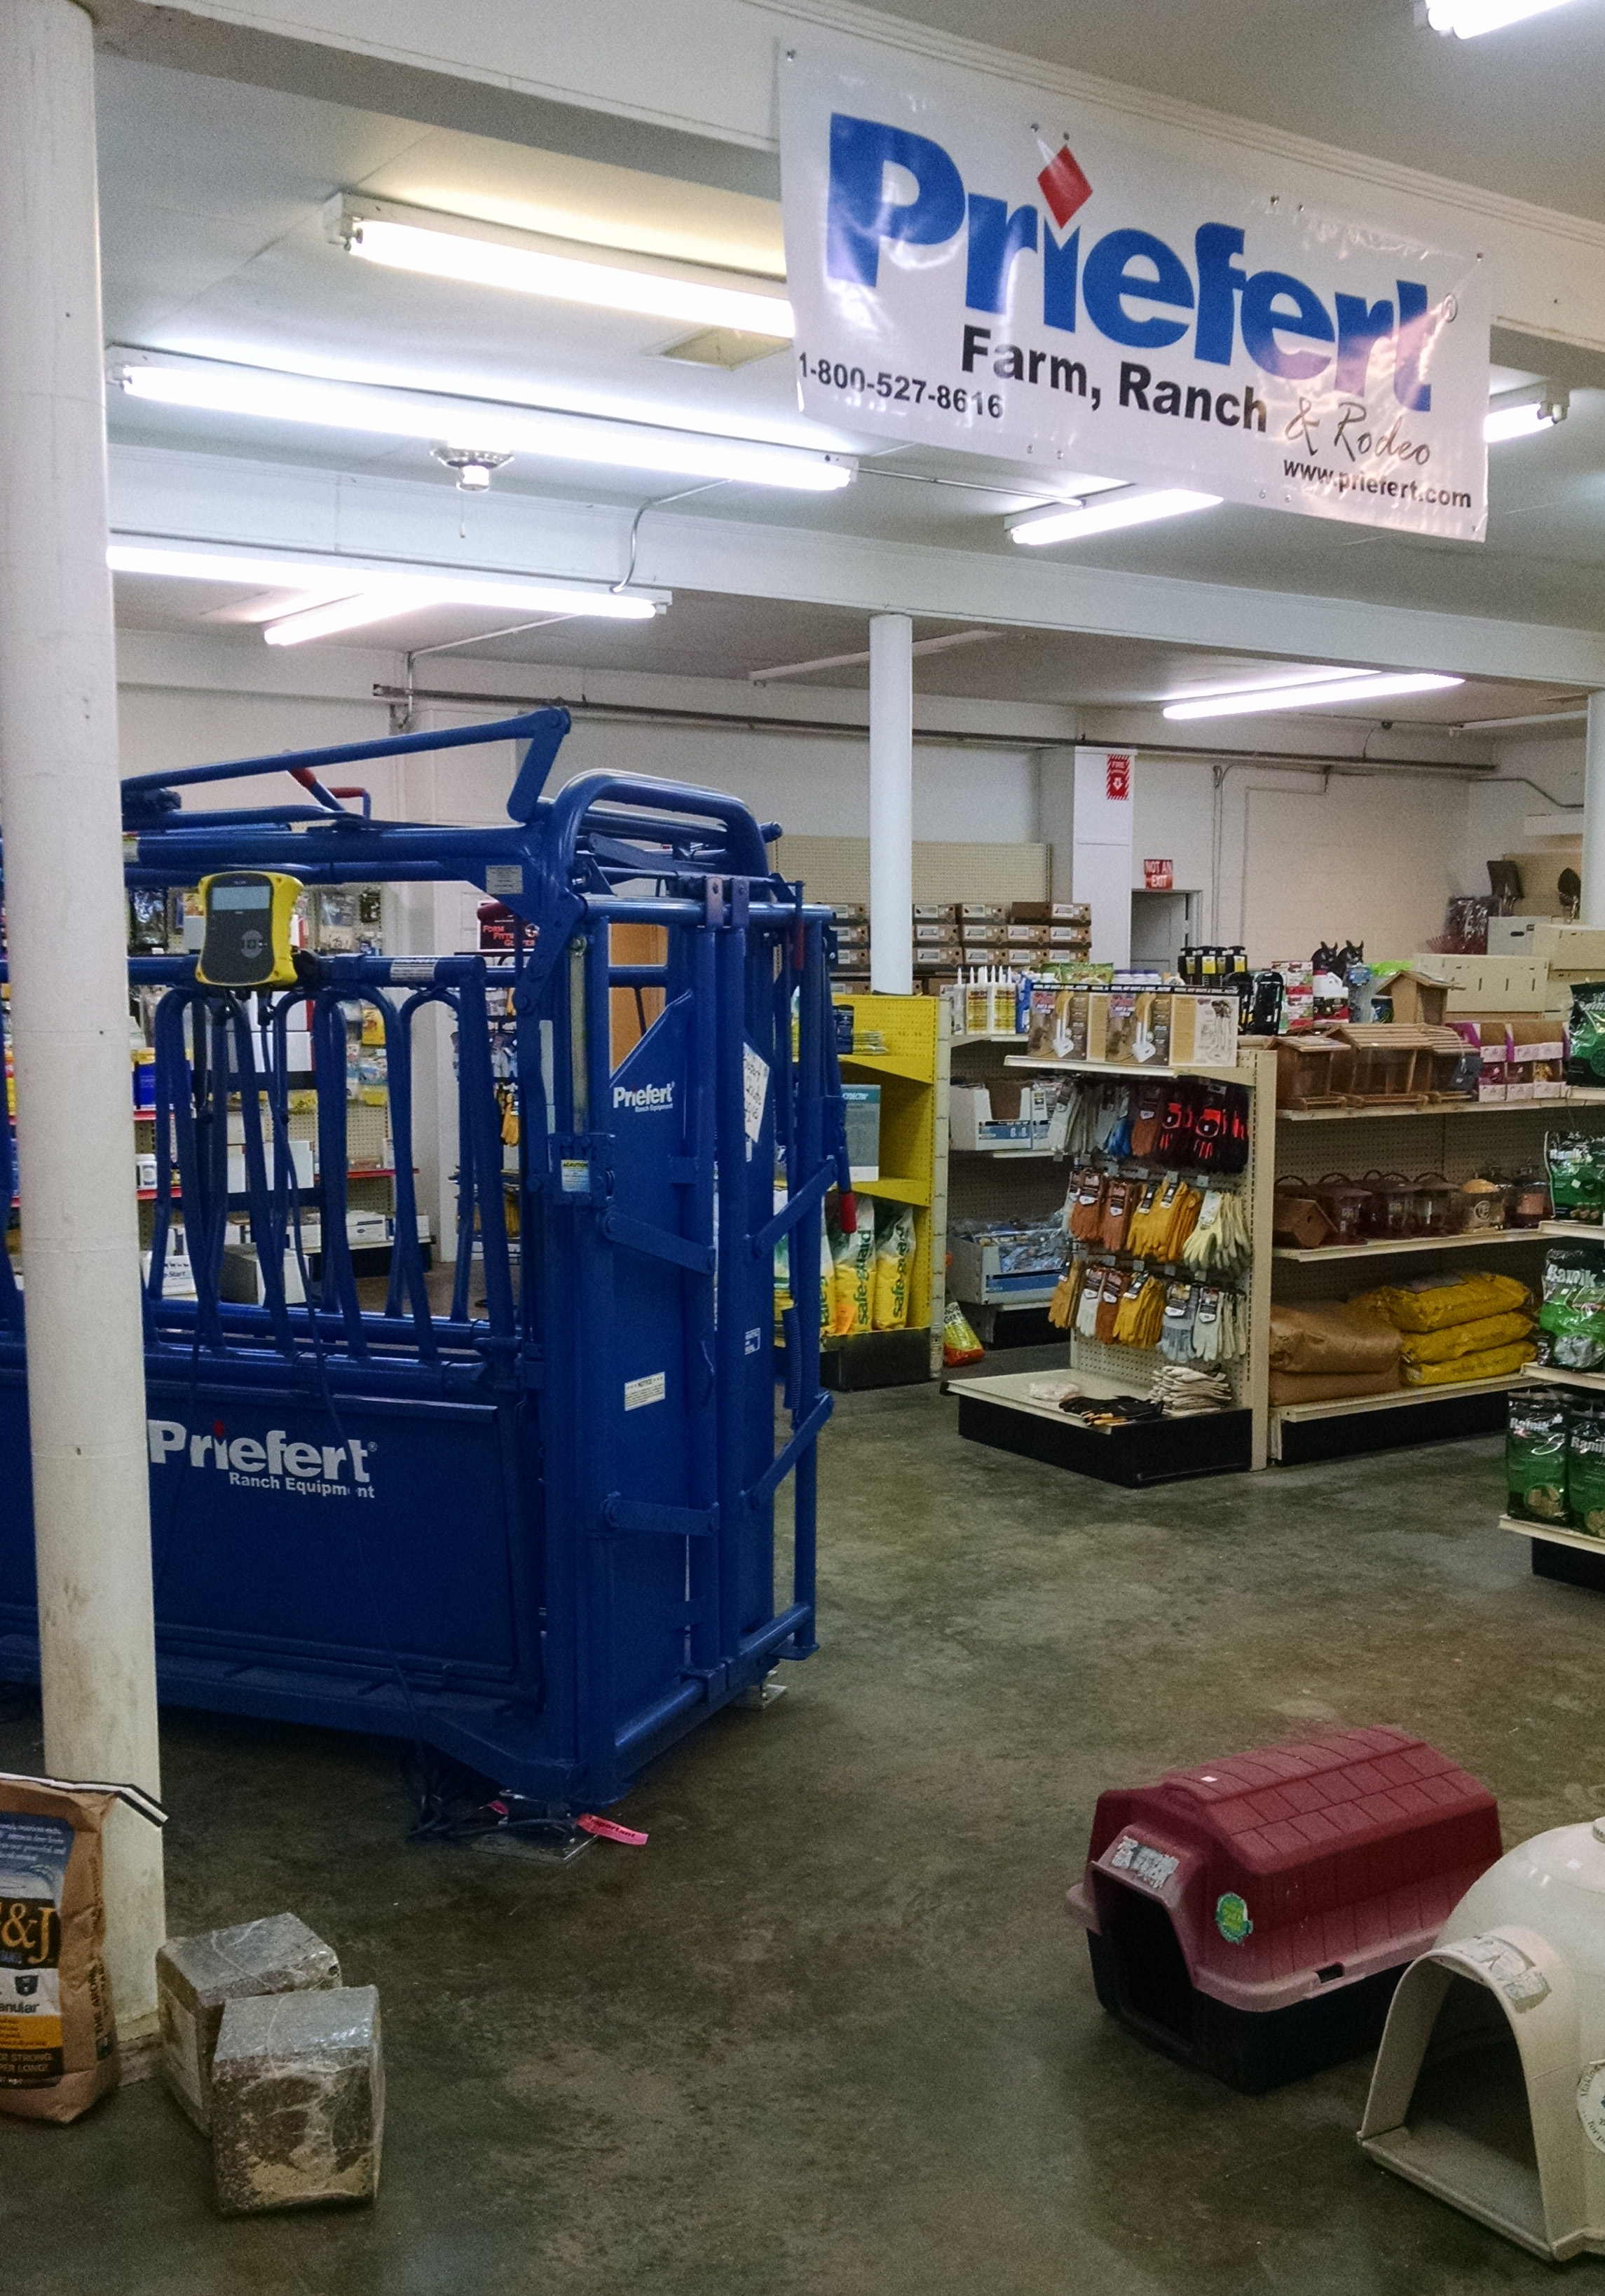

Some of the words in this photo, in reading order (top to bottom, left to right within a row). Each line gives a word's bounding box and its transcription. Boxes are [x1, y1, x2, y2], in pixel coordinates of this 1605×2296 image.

[828, 112, 1431, 412] Priefert
[800, 351, 1003, 418] 1-800-527-8616
[962, 324, 1101, 411] Farm,
[1119, 360, 1266, 432] Ranch
[1285, 397, 1320, 456] &
[1334, 402, 1430, 465] Rodeo
[1283, 459, 1471, 507] www.priefert.com
[1145, 861, 1160, 874] NOT
[1151, 876, 1167, 888] EXIT
[613, 1084, 673, 1108] Priefert
[1546, 1264, 1597, 1287] Ramik
[147, 1419, 370, 1483] Priefert
[229, 1472, 280, 1490] Ranch
[285, 1477, 375, 1498] Equipmnt
